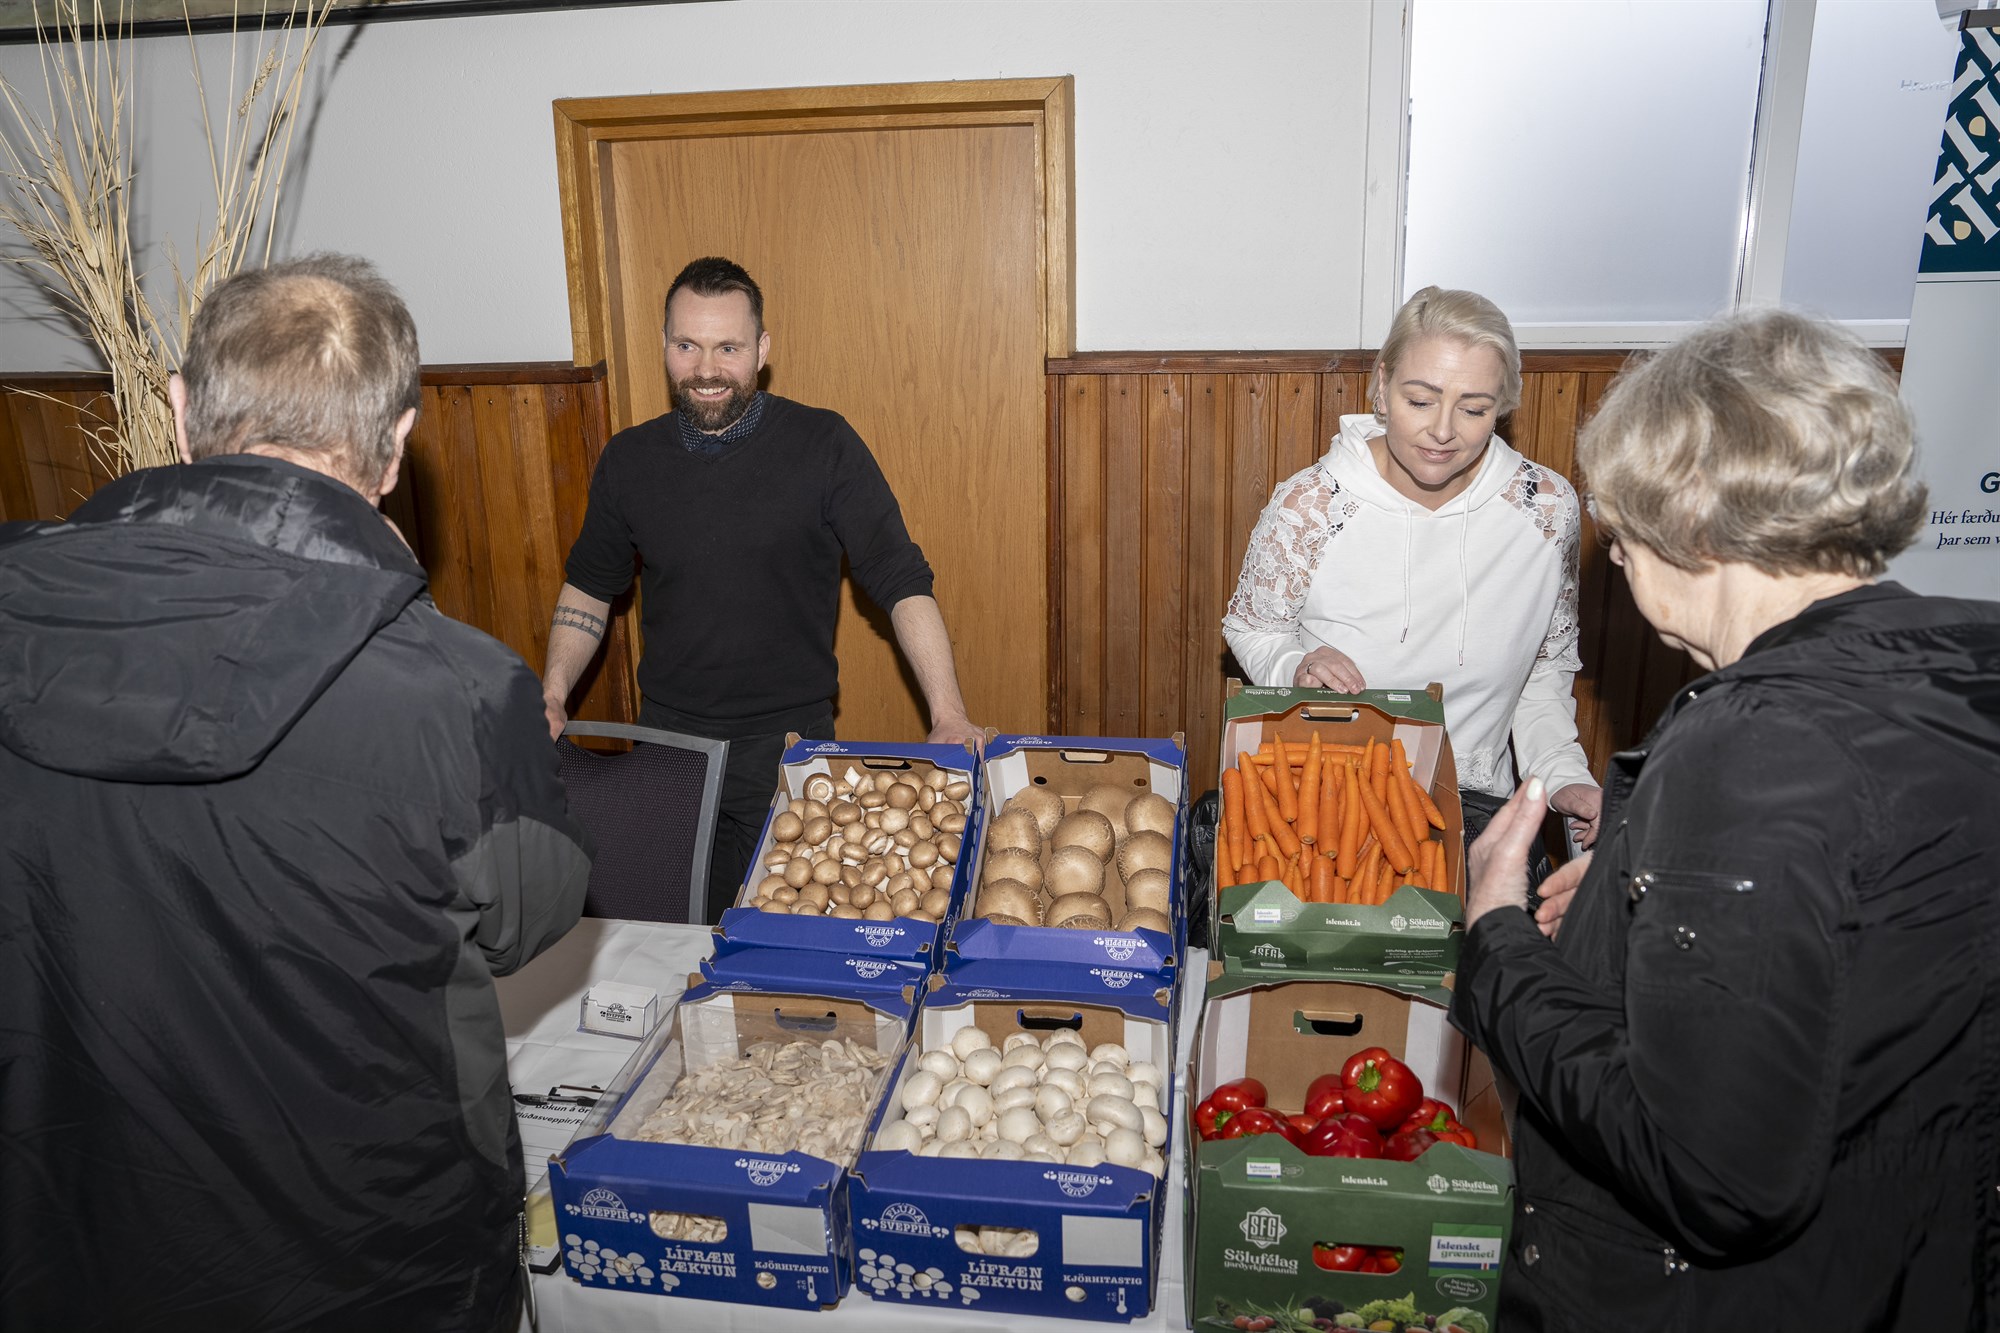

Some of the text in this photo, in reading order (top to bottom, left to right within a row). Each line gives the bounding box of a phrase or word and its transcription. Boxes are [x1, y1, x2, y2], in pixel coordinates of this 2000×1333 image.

[1931, 510, 1958, 525] Hér
[1936, 532, 1961, 550] þar
[1963, 536, 1991, 545] sem
[749, 1159, 787, 1172] SVEPPIR
[1058, 1172, 1098, 1184] SVEPPIR
[1341, 1175, 1388, 1186] islenskt.is
[582, 1206, 629, 1220] SVEPPIR
[880, 1220, 931, 1235] SVEPPIR
[1250, 1215, 1277, 1238] SFG
[1437, 1239, 1481, 1251] Íslenskt
[665, 1244, 735, 1265] LÍFRÆN
[1224, 1248, 1298, 1270] Sölufélag
[1441, 1249, 1495, 1259] grænmeti
[659, 1258, 737, 1278] RÆKTUN
[754, 1260, 829, 1274] KJÖRHITASTIG
[968, 1259, 1042, 1279] LÍFRÆN
[960, 1273, 1043, 1292] RÆKTUN
[1063, 1273, 1142, 1286] KJÖRHITASTIG
